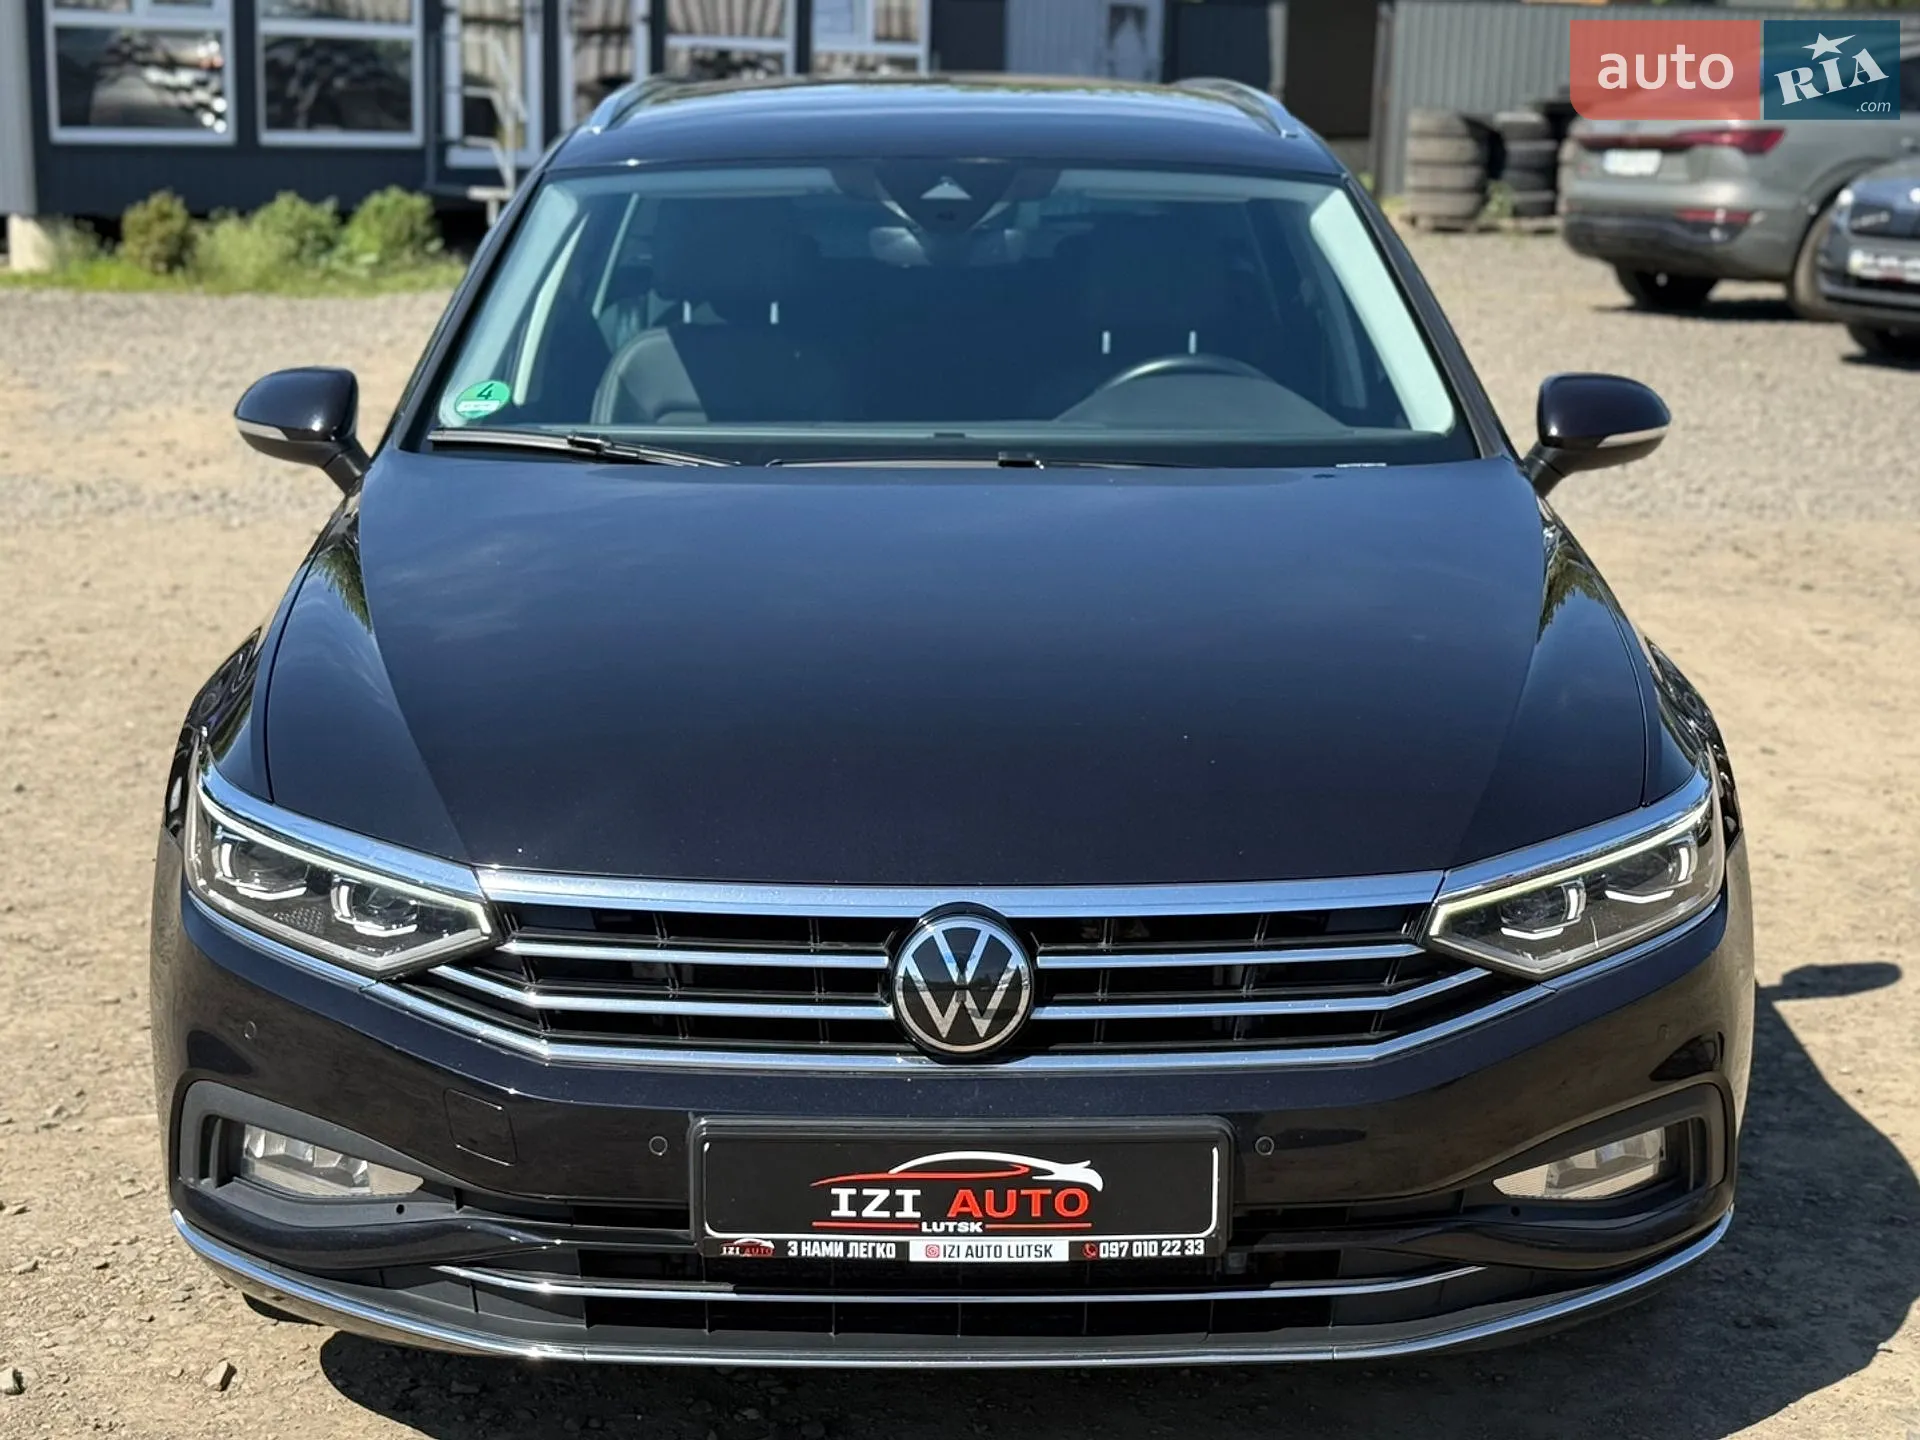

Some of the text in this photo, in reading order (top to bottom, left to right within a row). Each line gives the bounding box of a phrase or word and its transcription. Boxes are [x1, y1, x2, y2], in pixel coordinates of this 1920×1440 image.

[477, 383, 495, 400] 4
[830, 1187, 1090, 1218] IZI AUTO
[921, 1221, 984, 1233] LUTSK
[722, 1246, 774, 1257] IZI AUTO
[801, 1241, 844, 1257] НАМИ
[846, 1241, 897, 1259] ЛЕГКО
[942, 1243, 1054, 1258] IZI AUTO LUTSK
[1099, 1239, 1205, 1258] 097 010 22 33
